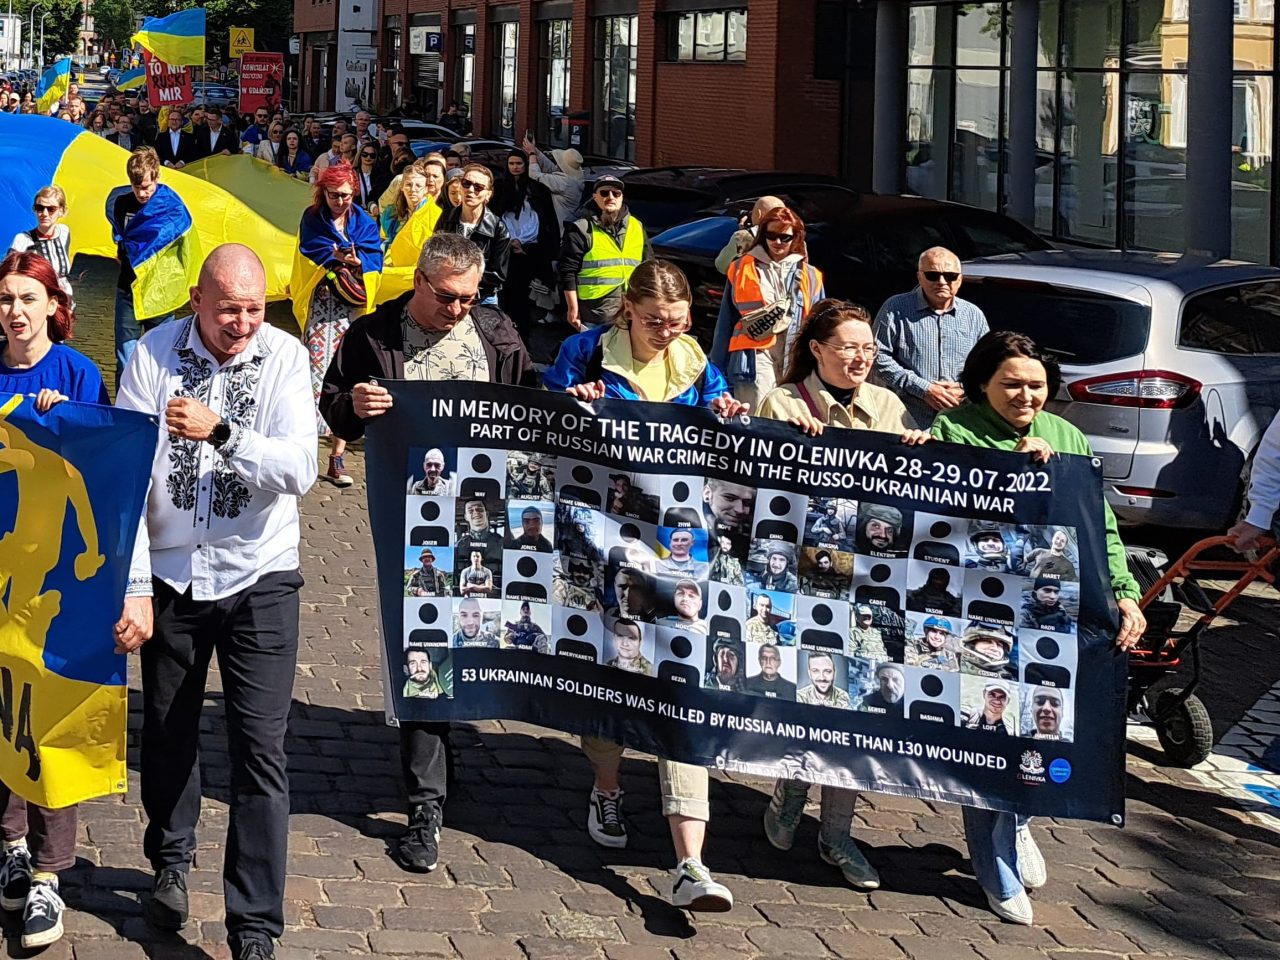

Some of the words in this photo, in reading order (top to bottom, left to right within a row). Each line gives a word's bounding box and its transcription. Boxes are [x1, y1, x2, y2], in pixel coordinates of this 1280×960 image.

[148, 62, 162, 76] TO
[167, 64, 186, 75] NIE
[159, 87, 183, 101] MIR
[746, 305, 786, 339] KUBOTA
[432, 398, 453, 417] IN
[459, 400, 557, 426] MEMORY
[561, 413, 593, 433] OF
[597, 417, 640, 441] THE
[646, 422, 748, 455] TRAGEDY
[750, 438, 772, 458] IN
[779, 441, 889, 474] OLENIVKA
[894, 456, 1051, 493] 28-29.07.2022
[470, 423, 513, 440] PART
[517, 427, 541, 442] OF
[546, 432, 623, 460] RUSSIAN
[627, 447, 664, 464] WAR
[666, 448, 729, 471] CRIMES
[733, 460, 752, 477] IN
[757, 462, 791, 482] THE
[797, 468, 968, 508] RUSSO-UKRAINIAN
[972, 493, 1016, 514] WAR
[924, 555, 951, 564] STUDENT
[869, 598, 886, 606] CADET
[985, 617, 1014, 626] UNKNOWN
[461, 668, 477, 683] 53
[479, 668, 553, 690] UKRAINIAN
[556, 677, 623, 704] SOLDIERS
[625, 694, 655, 713] WAS
[658, 700, 705, 724] KILLED
[710, 713, 725, 728] BY
[727, 714, 774, 736] RUSSIA
[776, 724, 806, 741] AND
[808, 728, 850, 747] MORE
[853, 733, 894, 753] THAN
[897, 740, 923, 757] 130
[925, 744, 1008, 771] WOUNDED
[982, 724, 997, 732] LOFT
[1016, 773, 1046, 783] OLENIVKA
